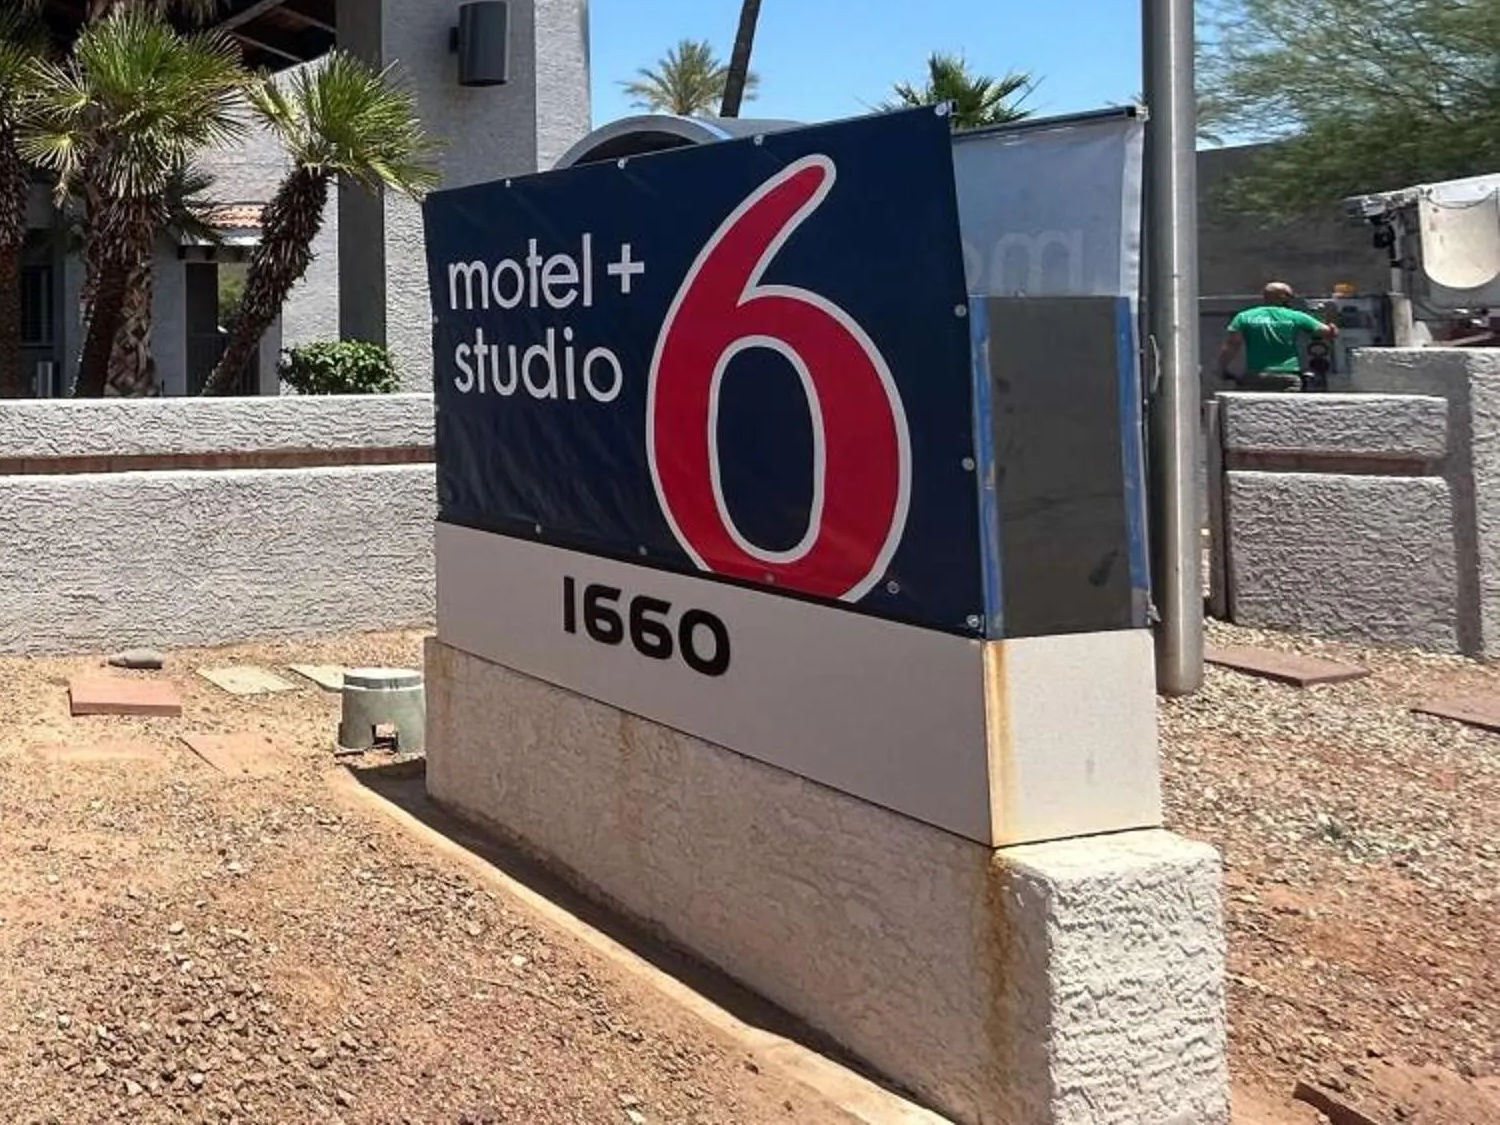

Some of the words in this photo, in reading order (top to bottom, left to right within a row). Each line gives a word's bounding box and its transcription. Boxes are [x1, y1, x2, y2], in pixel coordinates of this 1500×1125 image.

[448, 232, 593, 310] motel
[453, 326, 623, 402] studio
[645, 153, 913, 604] 6
[562, 575, 731, 678] 1660
